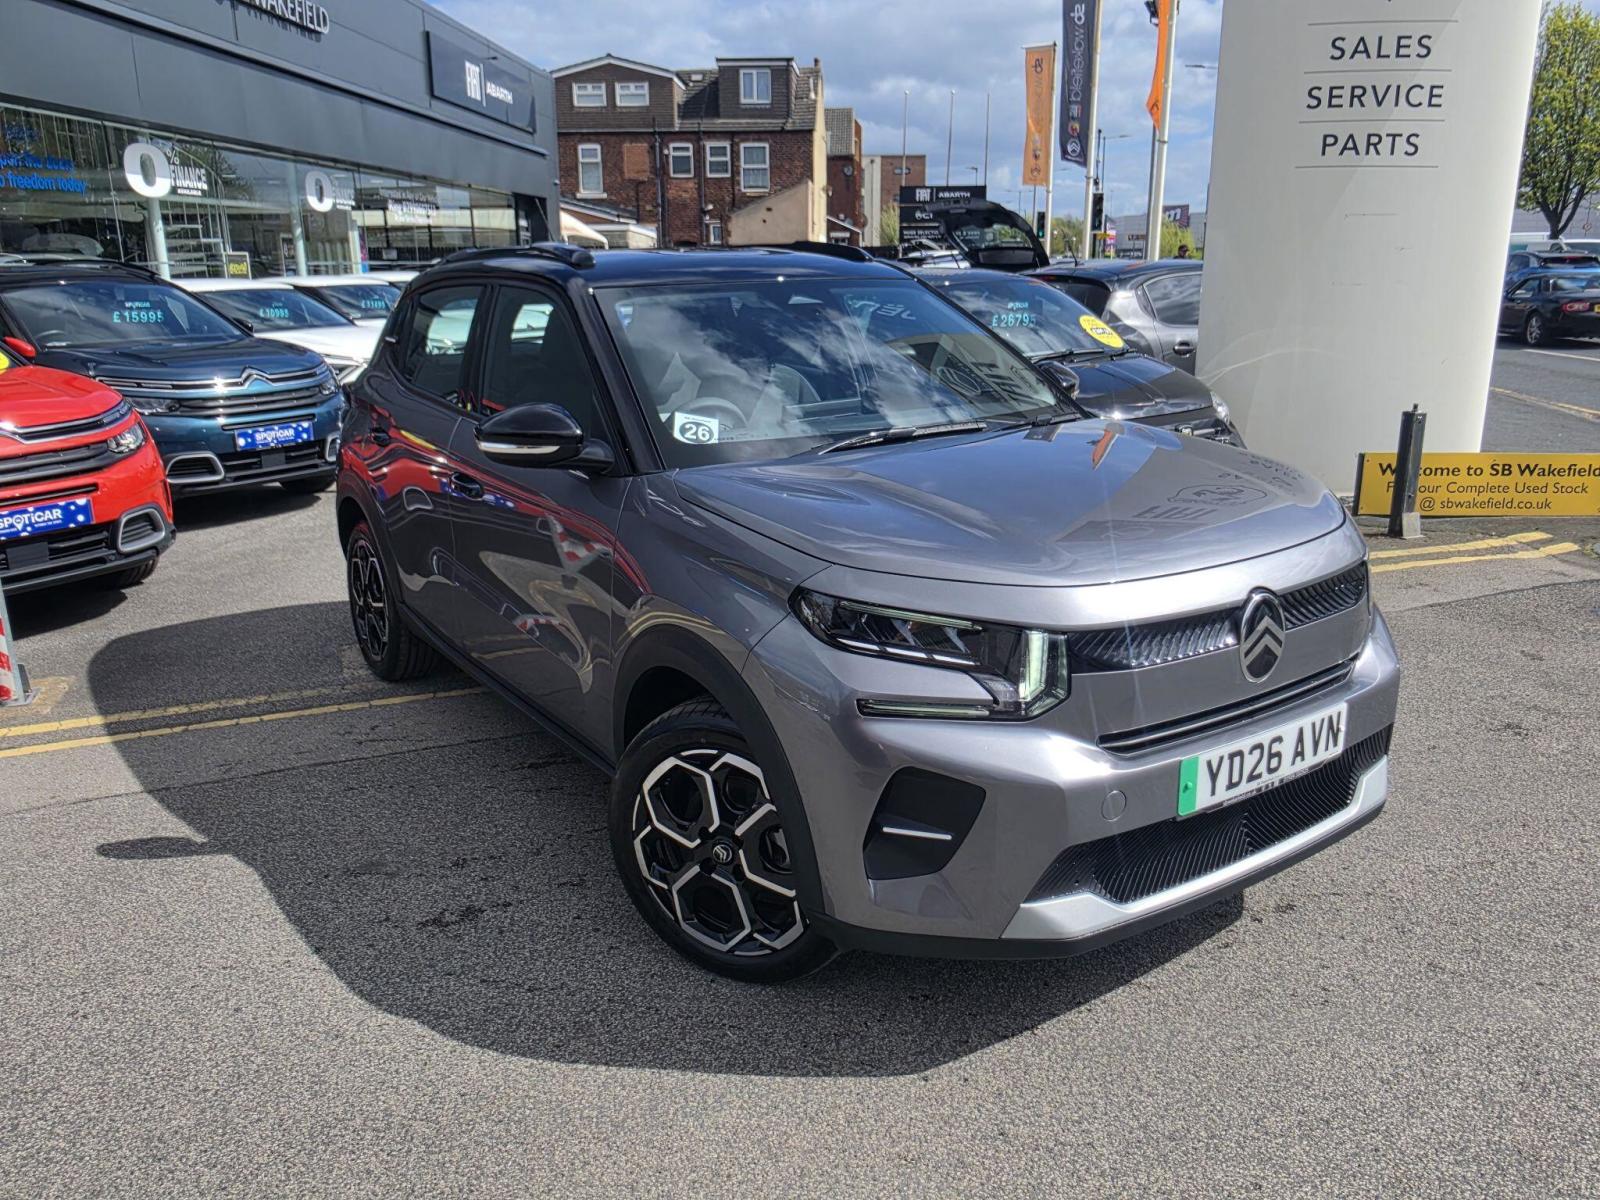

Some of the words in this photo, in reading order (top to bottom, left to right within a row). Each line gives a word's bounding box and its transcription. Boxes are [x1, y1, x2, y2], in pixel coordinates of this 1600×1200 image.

[1329, 34, 1433, 61] SALES
[1306, 84, 1444, 110] SERVICE
[1320, 133, 1421, 157] PARTS
[7, 171, 57, 192] freedom
[169, 164, 208, 190] FINANCE
[938, 191, 971, 199] ABARTH
[684, 423, 711, 441] 26
[1466, 465, 1484, 477] to
[1489, 463, 1513, 477] SB
[1446, 481, 1510, 495] Complete
[1515, 482, 1549, 494] Used
[1552, 482, 1589, 494] Stock
[1420, 497, 1436, 511] @
[1440, 496, 1553, 509] sbwakefield.co.uk
[1206, 735, 1284, 797] YD26
[1290, 711, 1343, 767] AVN
